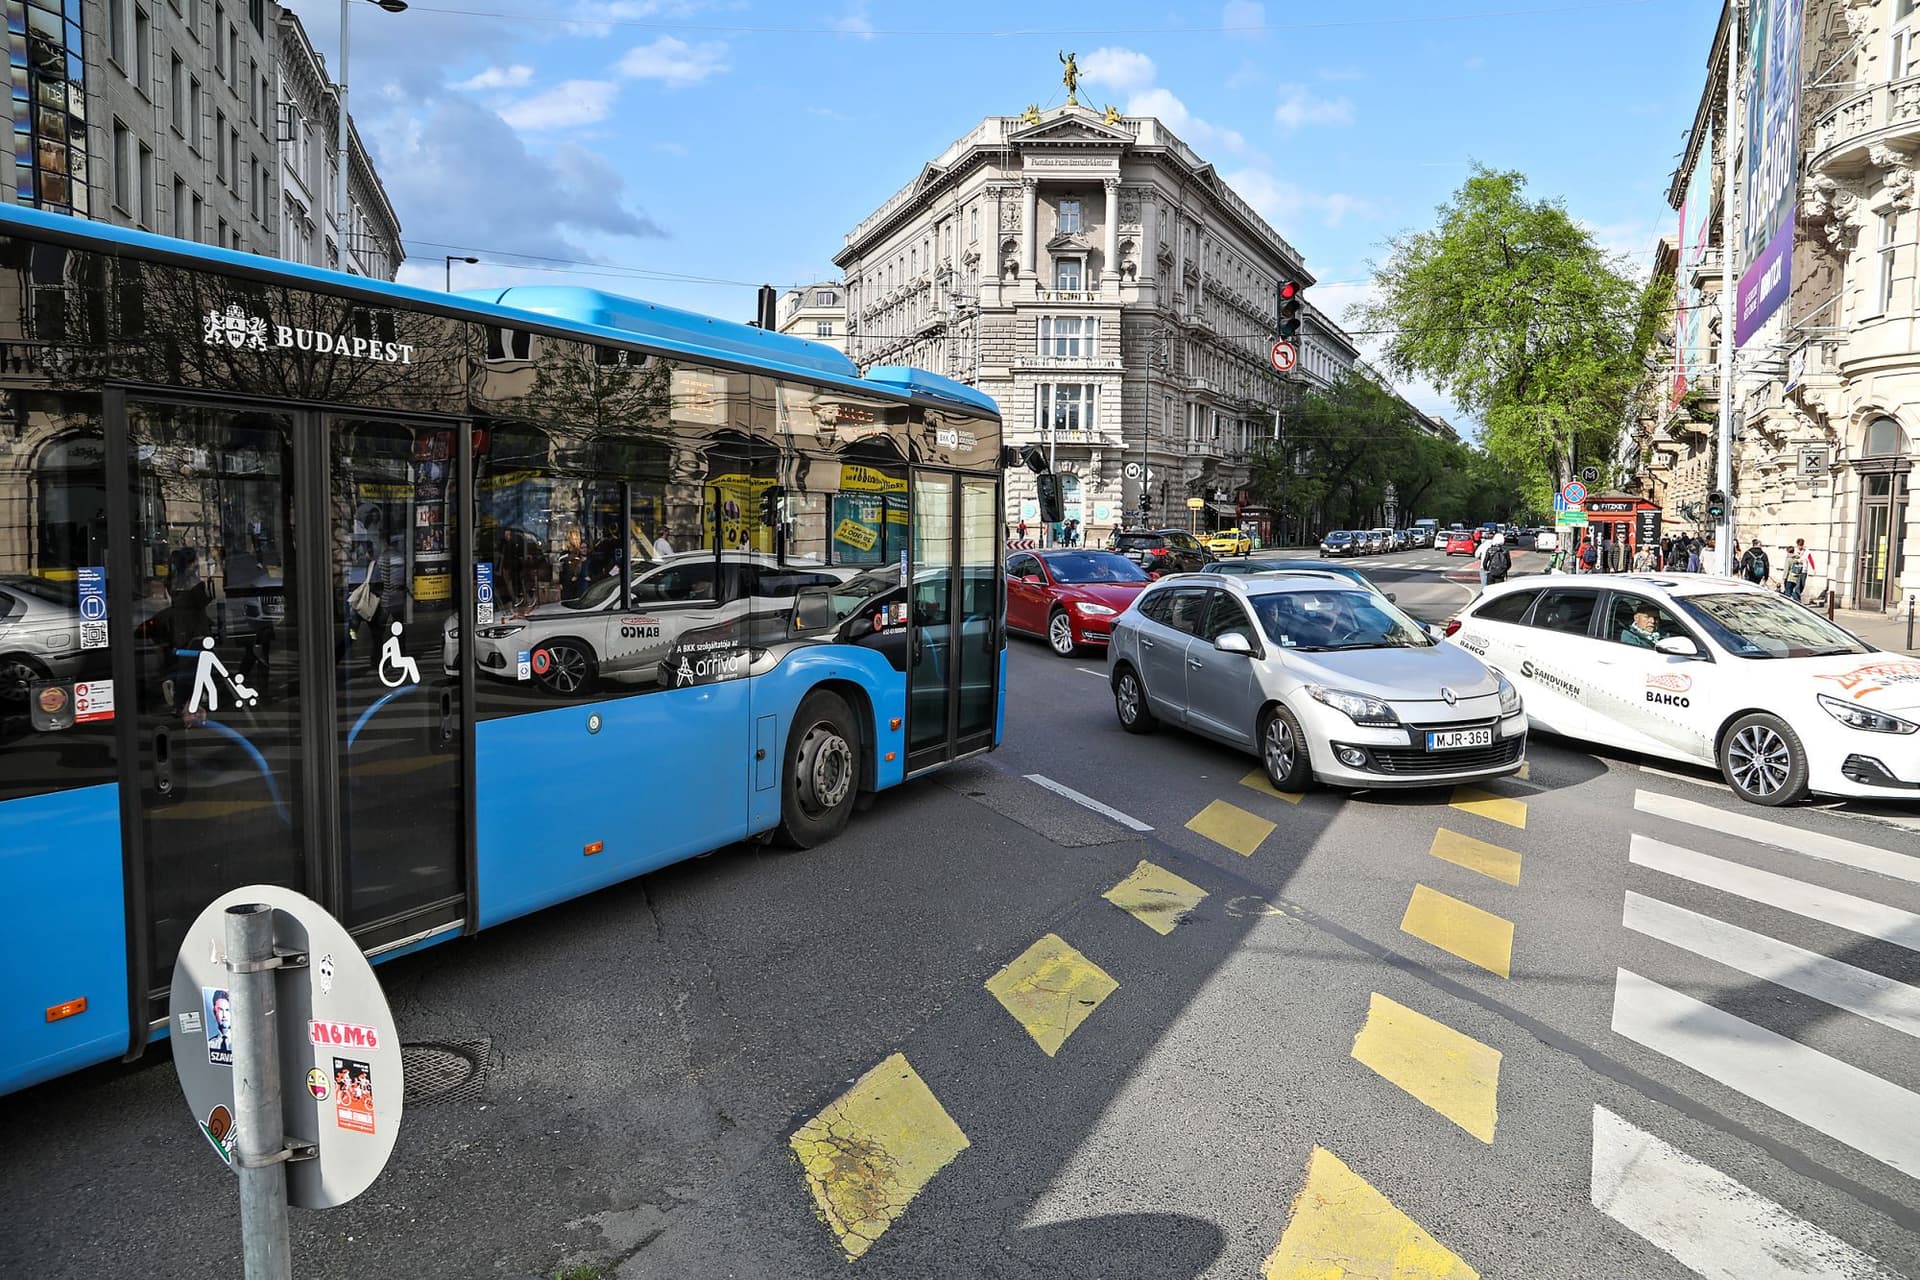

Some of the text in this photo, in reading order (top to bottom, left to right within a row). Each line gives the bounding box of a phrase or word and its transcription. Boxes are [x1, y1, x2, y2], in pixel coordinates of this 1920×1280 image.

[276, 326, 413, 364] BUDAPEST
[1459, 640, 1486, 656] BAHCO
[696, 653, 738, 676] arriva
[1534, 667, 1581, 695] SANDVIKEN
[1646, 691, 1690, 708] BAHCO
[1436, 730, 1489, 747] MJR-369
